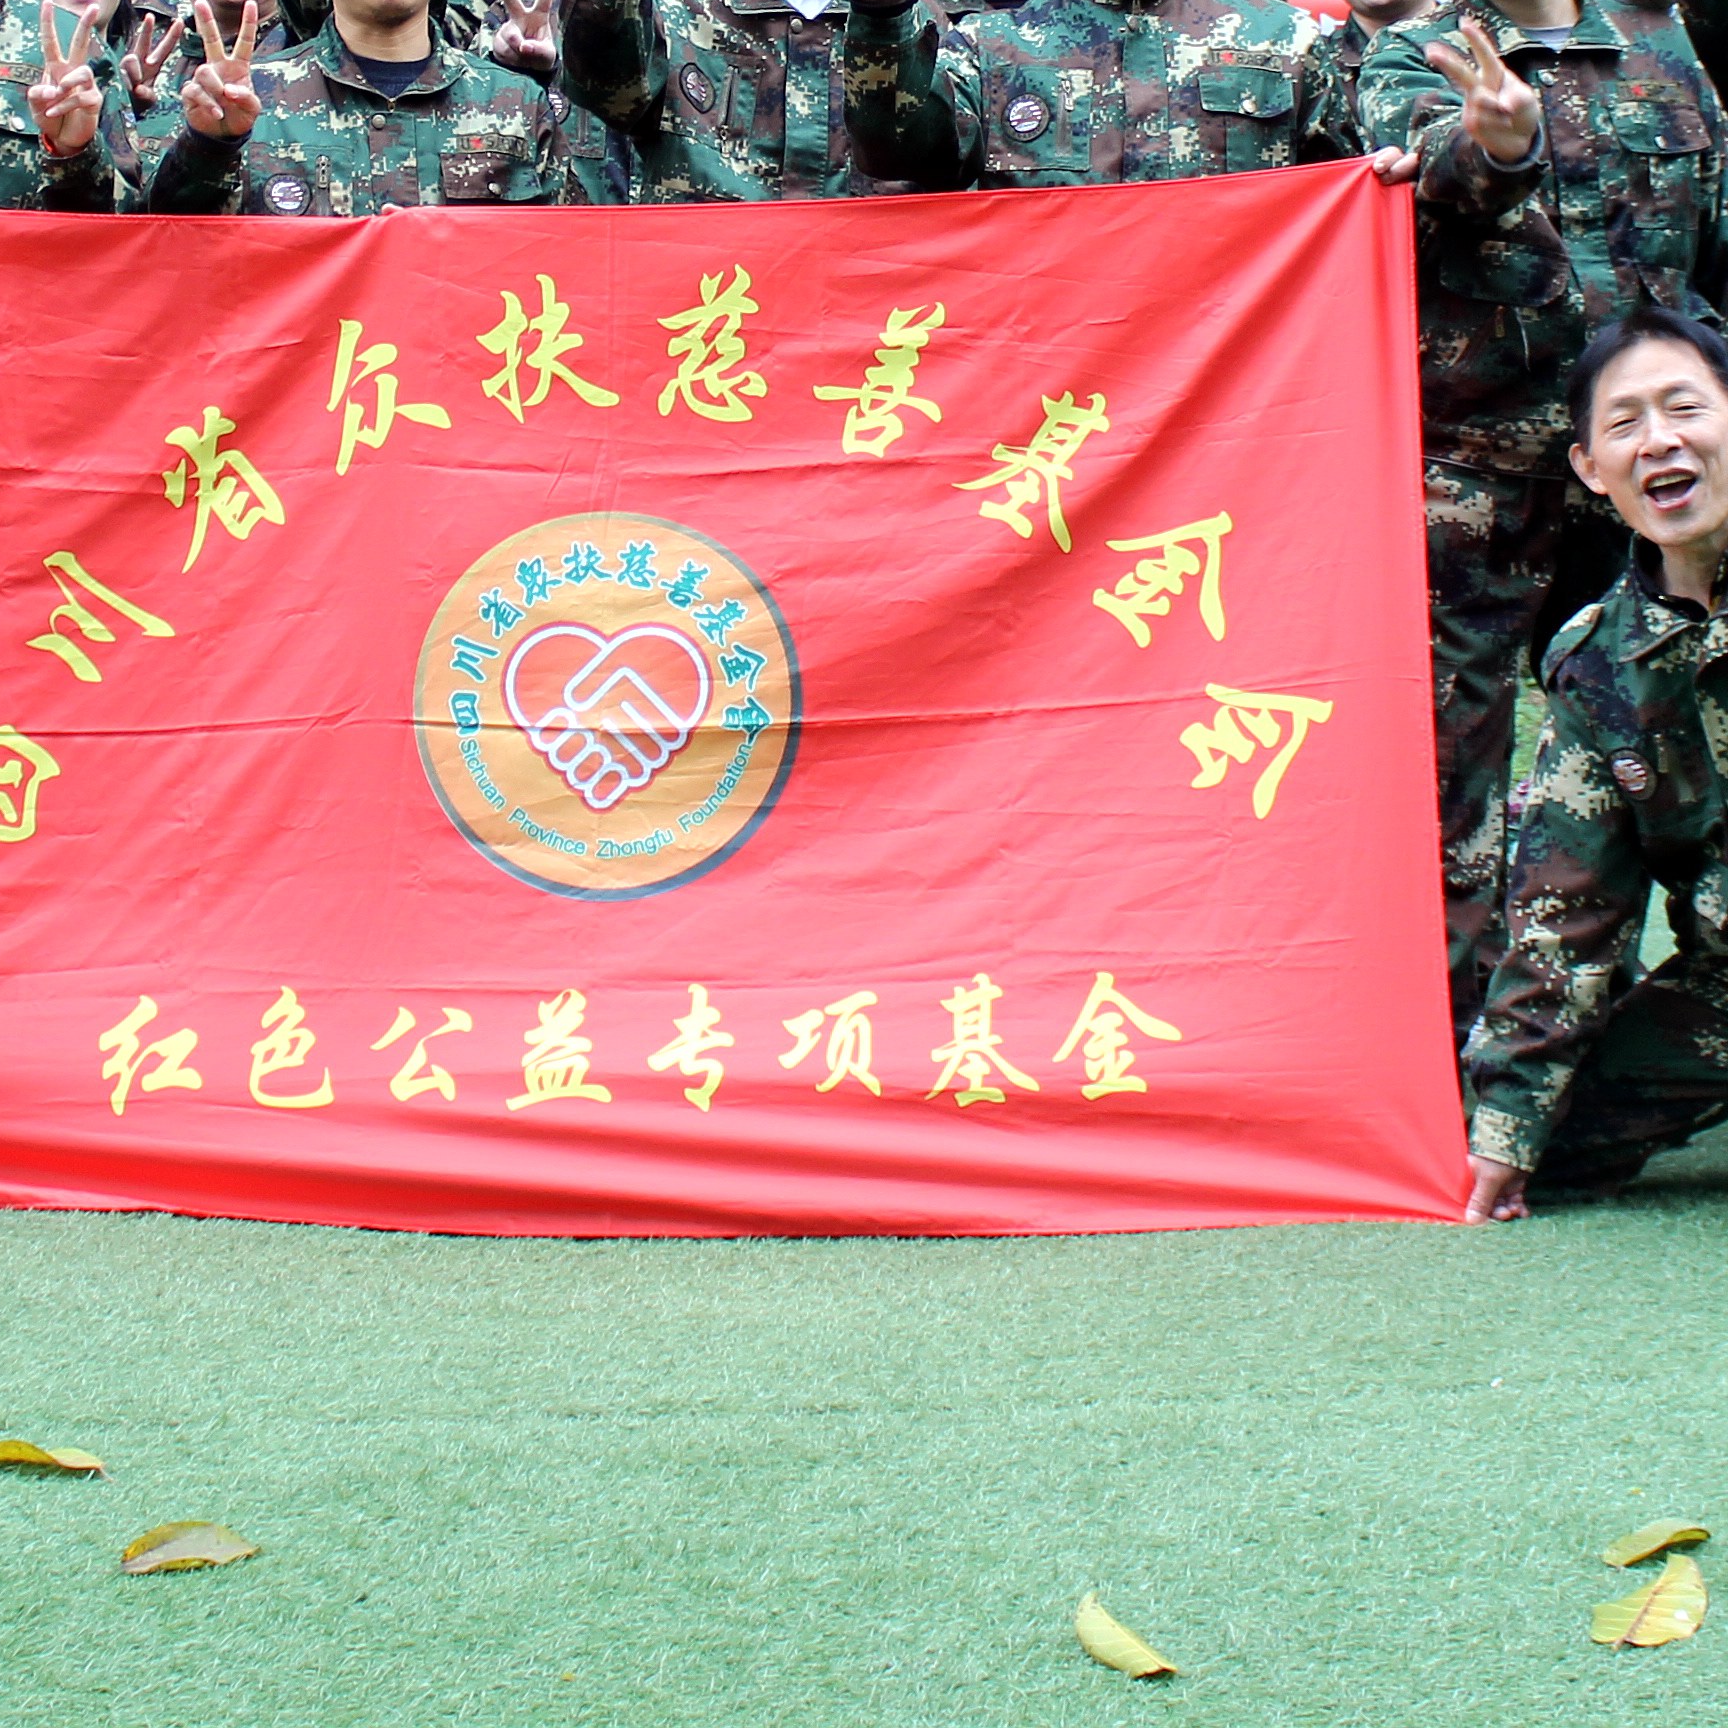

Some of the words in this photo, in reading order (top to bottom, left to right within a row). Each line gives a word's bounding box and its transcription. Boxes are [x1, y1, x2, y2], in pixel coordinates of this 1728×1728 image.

[459, 737, 507, 811] Sichuan
[508, 807, 588, 855] Province
[596, 828, 675, 859] Zhongfu
[677, 742, 753, 834] Foundation
[99, 971, 1182, 1115] 红色公益专项基金
